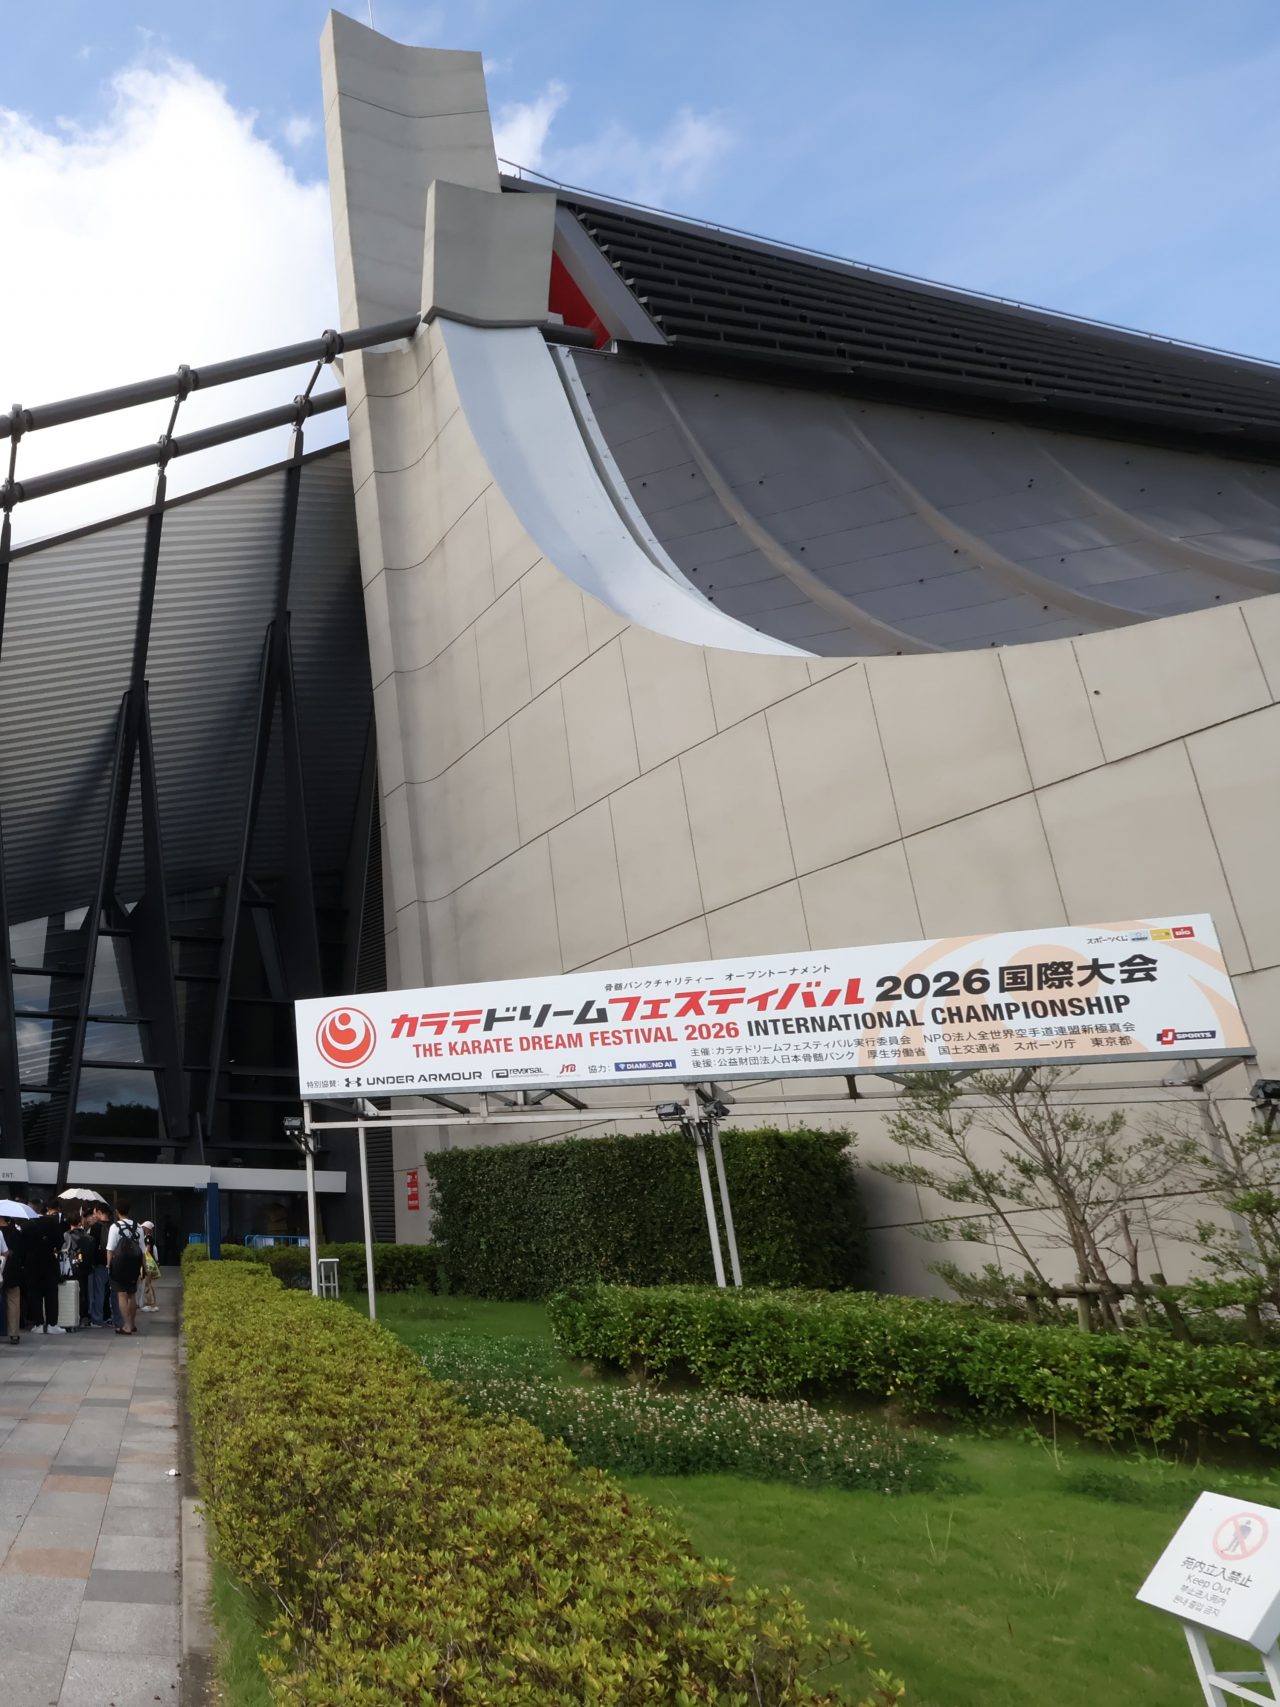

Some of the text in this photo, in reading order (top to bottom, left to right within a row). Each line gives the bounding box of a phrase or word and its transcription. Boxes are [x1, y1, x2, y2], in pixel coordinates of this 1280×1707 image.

[725, 964, 830, 982] オープントーナメント
[391, 978, 865, 1039] カラテドリームフェスティバル
[412, 994, 1131, 1058] THE KARATE DREAM FESTIVAL 2026 INTERNATIONAL CHAMPIONSHIP
[867, 1047, 926, 1059] 厚生労働省
[938, 1042, 1000, 1056] 国土交通省
[1014, 1039, 1077, 1051] スポーツ庁
[1091, 1035, 1133, 1048] 東京都
[560, 1063, 577, 1075] JTB
[626, 1062, 664, 1070] DIAMOND
[366, 1071, 483, 1086] UNDER ARMOUR
[1180, 1556, 1253, 1589] 苑内立入禁止
[1185, 1573, 1232, 1595] Keep Out
